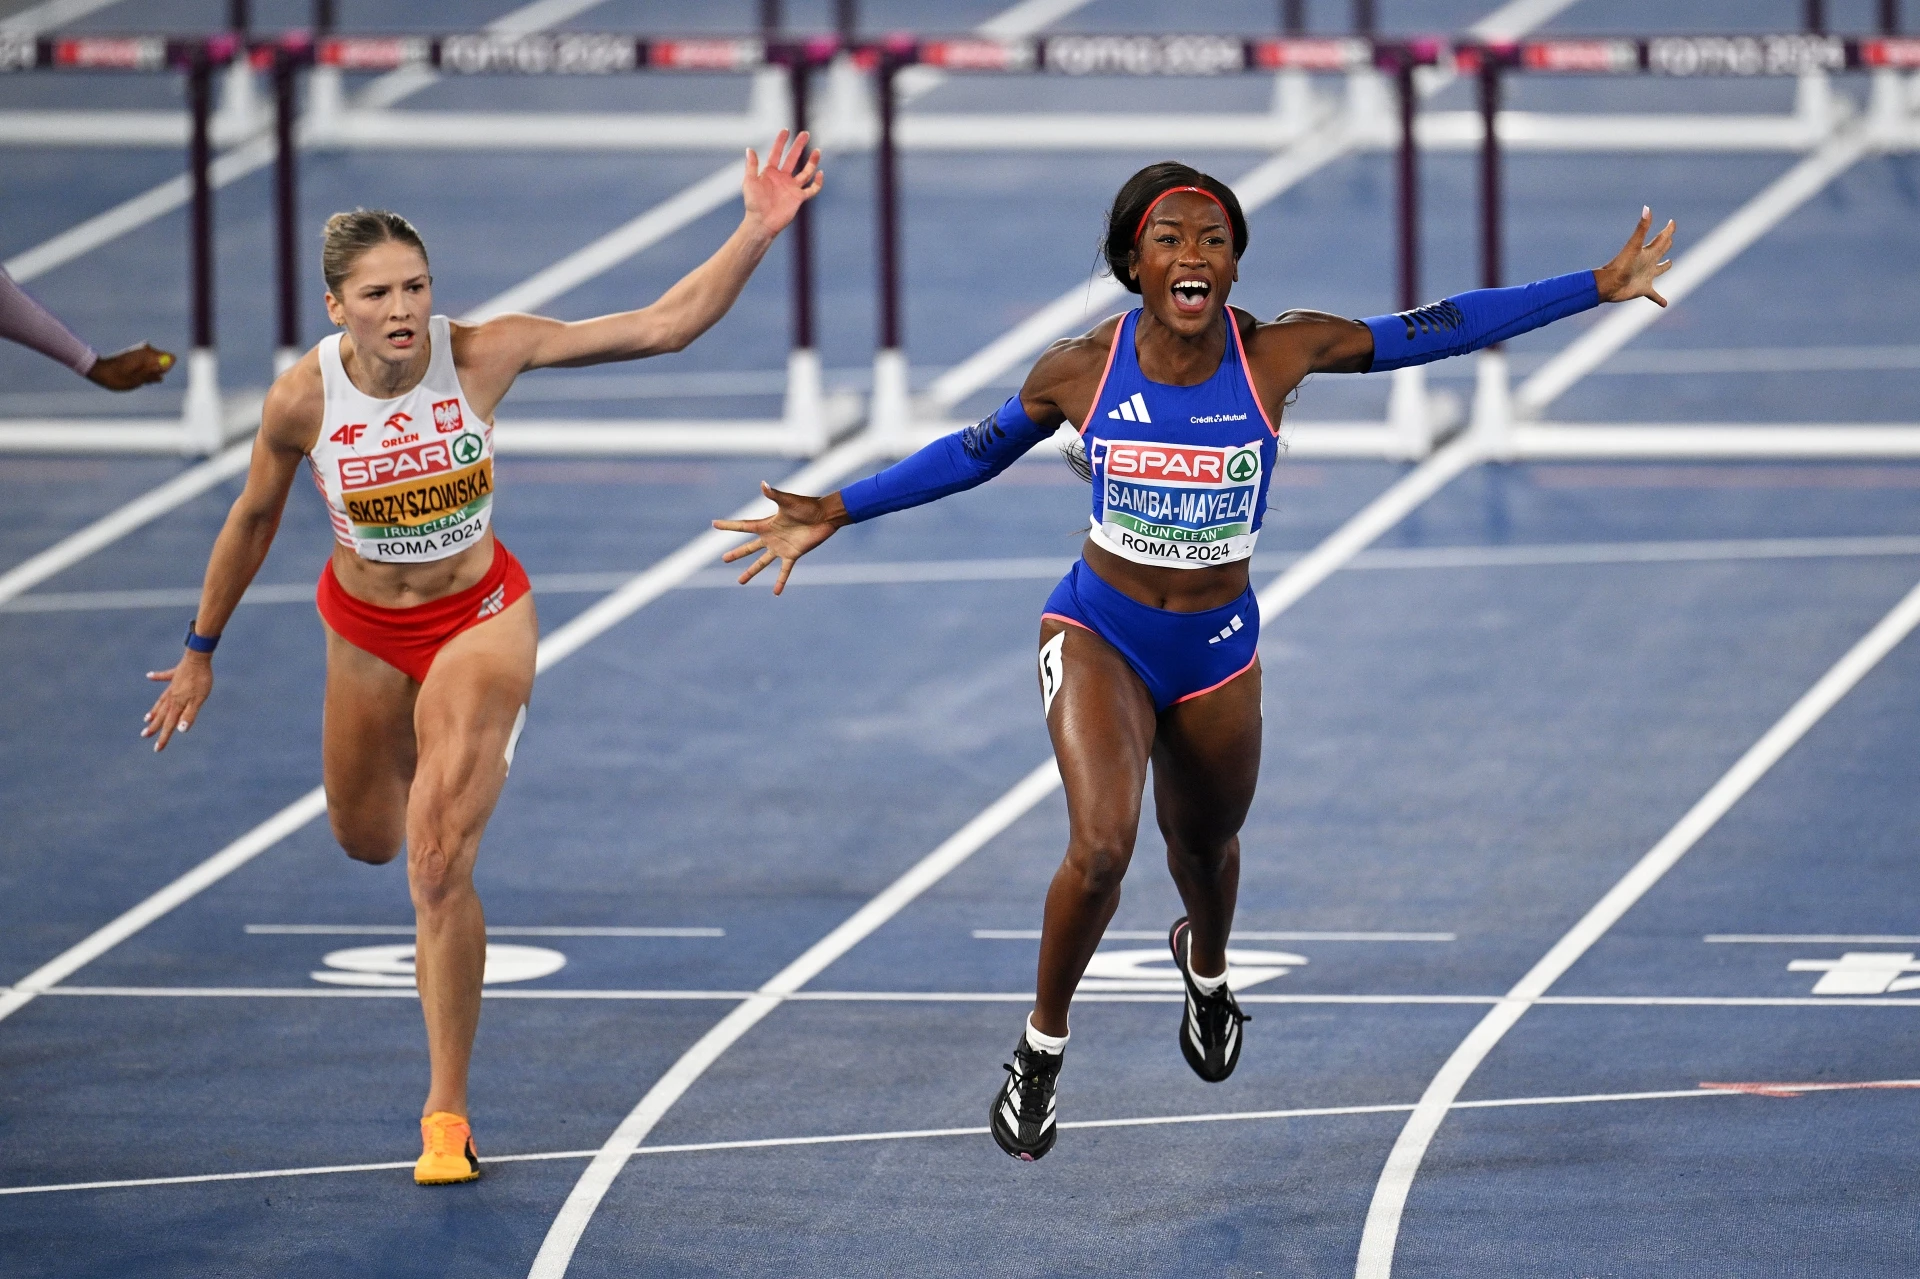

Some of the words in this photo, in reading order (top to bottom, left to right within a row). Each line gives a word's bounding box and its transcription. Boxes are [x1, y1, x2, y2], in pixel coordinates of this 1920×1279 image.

[1190, 416, 1213, 424] Crédit
[1222, 412, 1247, 422] Mutuel
[330, 424, 367, 445] 4F
[381, 433, 419, 448] ORLEN
[342, 446, 448, 486] SPAR
[1111, 449, 1221, 478] SPAR
[348, 468, 489, 523] SKRZYSZOWSKA
[1107, 482, 1250, 524] SAMBA-MAYELA
[377, 539, 437, 556] ROMA
[440, 518, 483, 548] 2024
[392, 526, 421, 537] RUN
[1133, 520, 1139, 530] I
[1140, 522, 1170, 539] RUN
[1121, 533, 1181, 559] ROMA
[1185, 542, 1231, 561] 2024
[1043, 649, 1054, 697] 5
